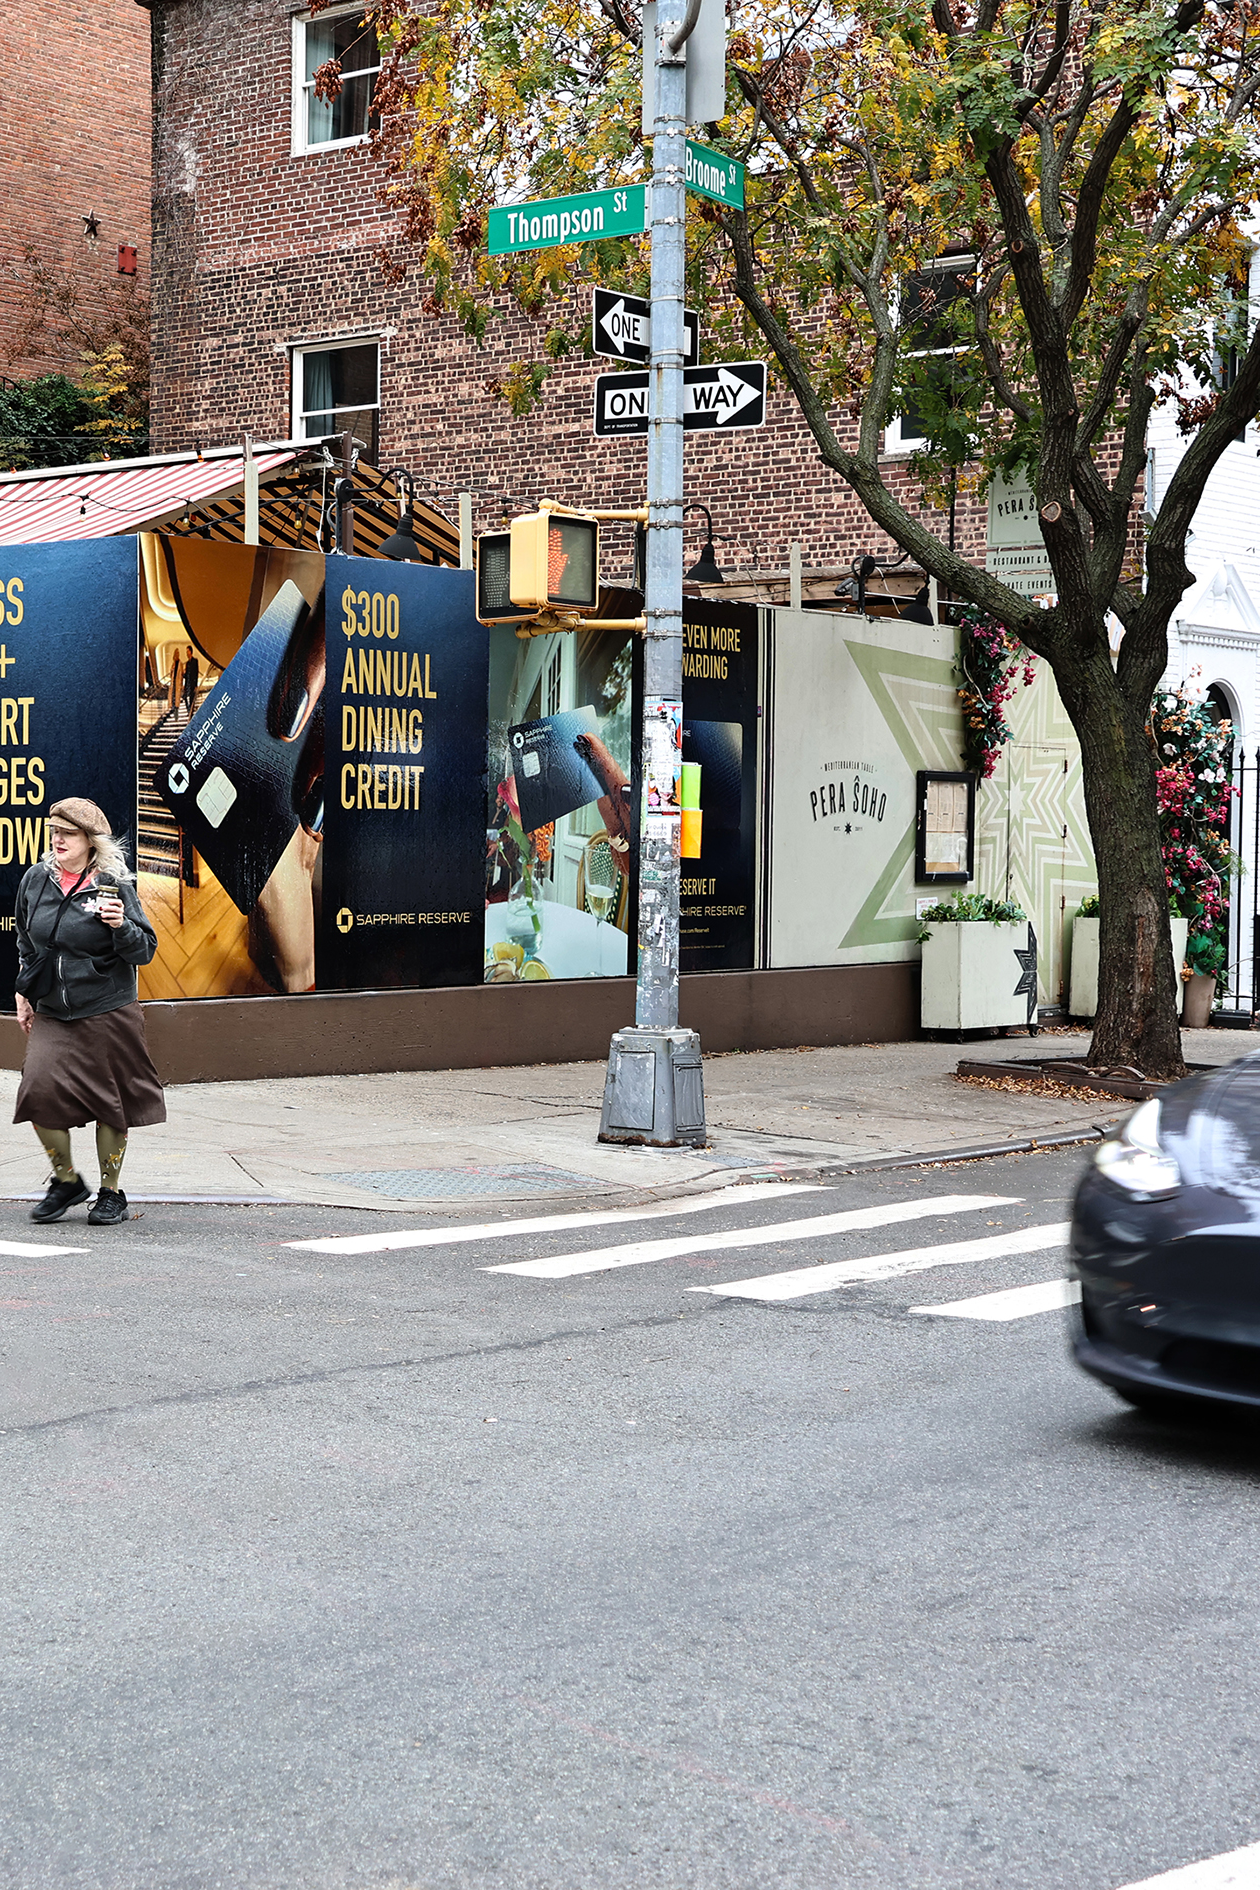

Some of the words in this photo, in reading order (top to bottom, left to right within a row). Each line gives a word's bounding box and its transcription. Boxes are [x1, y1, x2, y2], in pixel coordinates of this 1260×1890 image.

[685, 146, 726, 197] Broome
[728, 163, 736, 186] St
[507, 205, 604, 244] Thompson
[613, 191, 628, 213] St
[611, 312, 641, 341] ONE
[610, 390, 649, 416] ON
[693, 384, 745, 411] WAY
[997, 498, 1024, 517] PERA
[993, 556, 1034, 566] RESTAURANT
[1004, 581, 1023, 590] VATE
[1027, 580, 1052, 589] EVENTS
[341, 584, 400, 641] $300
[682, 623, 708, 650] EVEN
[711, 626, 741, 653] MORE
[341, 647, 438, 699] ANNUAL
[682, 653, 728, 680] WARDING
[184, 691, 232, 762] SAPPHIRE
[342, 705, 424, 755] DINING
[190, 721, 224, 770] RESERVE
[341, 762, 425, 811] CREDIT
[809, 781, 846, 821] PERA
[679, 878, 707, 895] ESERVE
[708, 878, 717, 895] IT
[356, 913, 416, 926] SAPPHIRE
[418, 911, 471, 924] RESERVE
[704, 905, 745, 916] RESERVE
